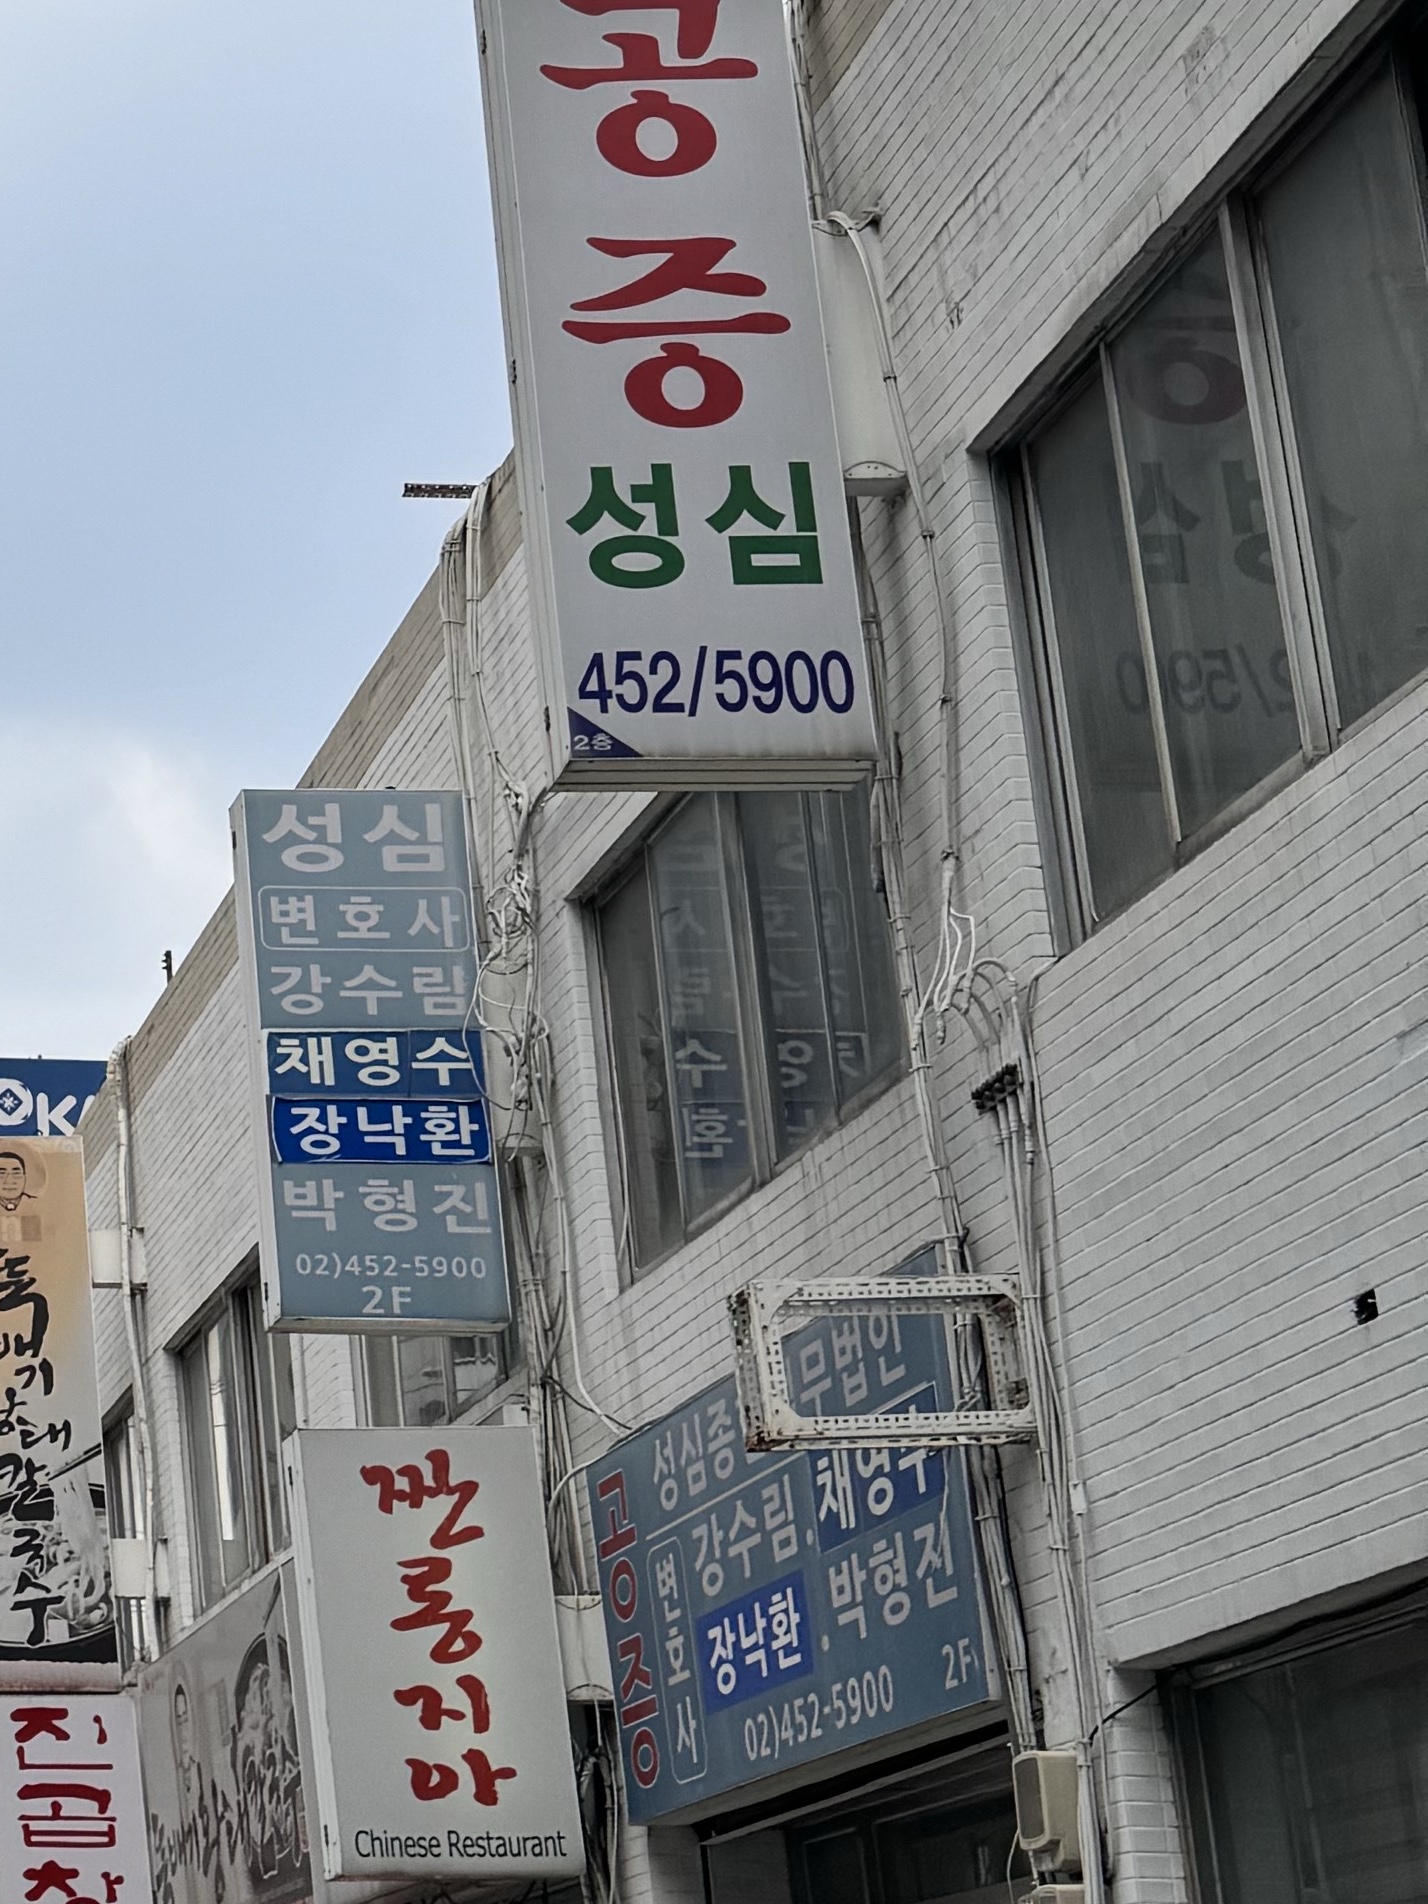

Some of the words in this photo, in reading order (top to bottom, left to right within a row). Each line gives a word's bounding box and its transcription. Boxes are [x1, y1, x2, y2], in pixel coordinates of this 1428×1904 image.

[565, 460, 826, 590] 성심
[577, 646, 856, 719] 452/5900
[572, 732, 614, 752] 2층
[262, 802, 447, 874] 성심
[269, 894, 461, 949] 변호사
[273, 1036, 475, 1088] 채영수
[288, 1104, 480, 1158] 장낙환
[282, 1177, 493, 1236] 박형진
[295, 1253, 488, 1281] 02)452-5900
[361, 1285, 413, 1316] 2F
[827, 1510, 958, 1641] 박형진
[596, 1468, 661, 1789] 공증
[655, 1552, 700, 1764] 변호사
[707, 1586, 804, 1696] 장낙환
[743, 1664, 896, 1763] 02)452-5900
[353, 1828, 443, 1859] Chinese
[447, 1828, 569, 1859] Restaurant
